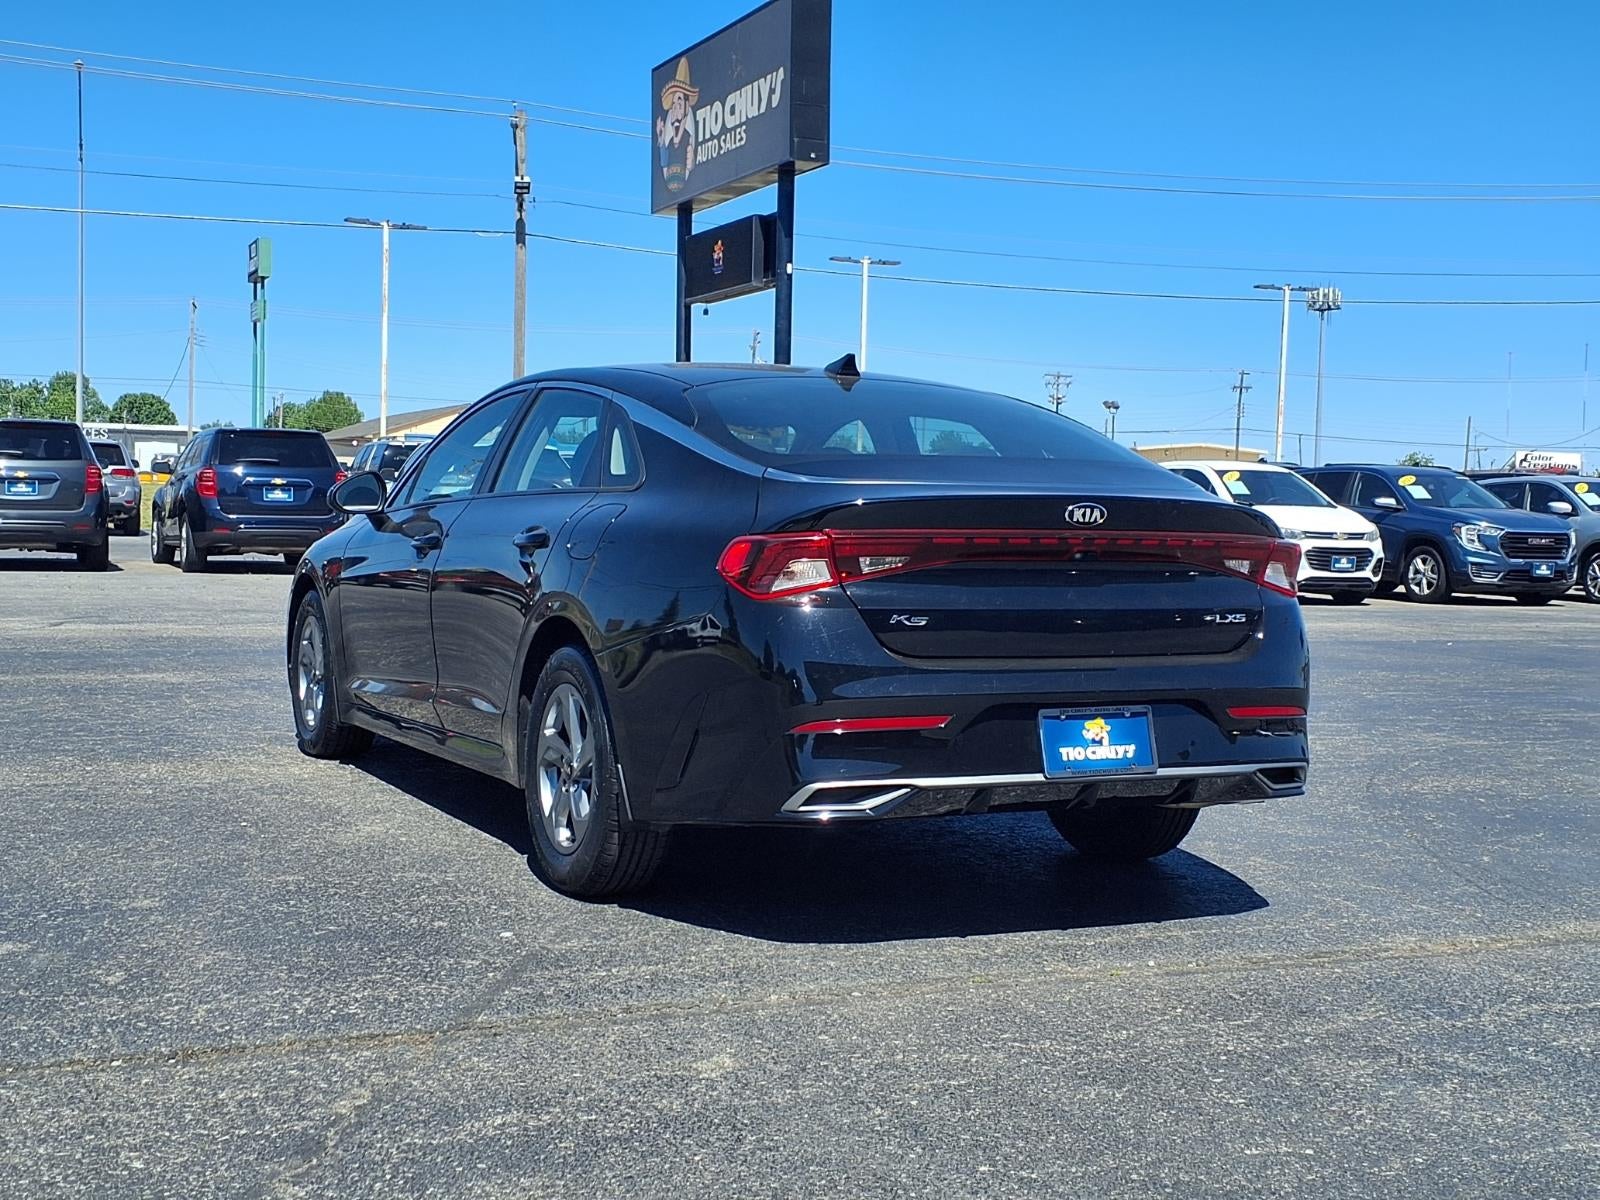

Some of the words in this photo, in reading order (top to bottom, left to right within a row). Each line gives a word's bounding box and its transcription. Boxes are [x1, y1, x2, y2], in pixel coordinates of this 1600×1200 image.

[696, 101, 723, 142] TIO
[724, 66, 785, 129] CHUY'S
[696, 139, 719, 165] AUTO
[720, 125, 746, 155] SALES
[1519, 459, 1578, 469] Creations
[1520, 453, 1554, 462] Color
[1073, 507, 1101, 522] KIA
[1059, 746, 1085, 761] TIO
[1086, 744, 1136, 760] CHUY'S
